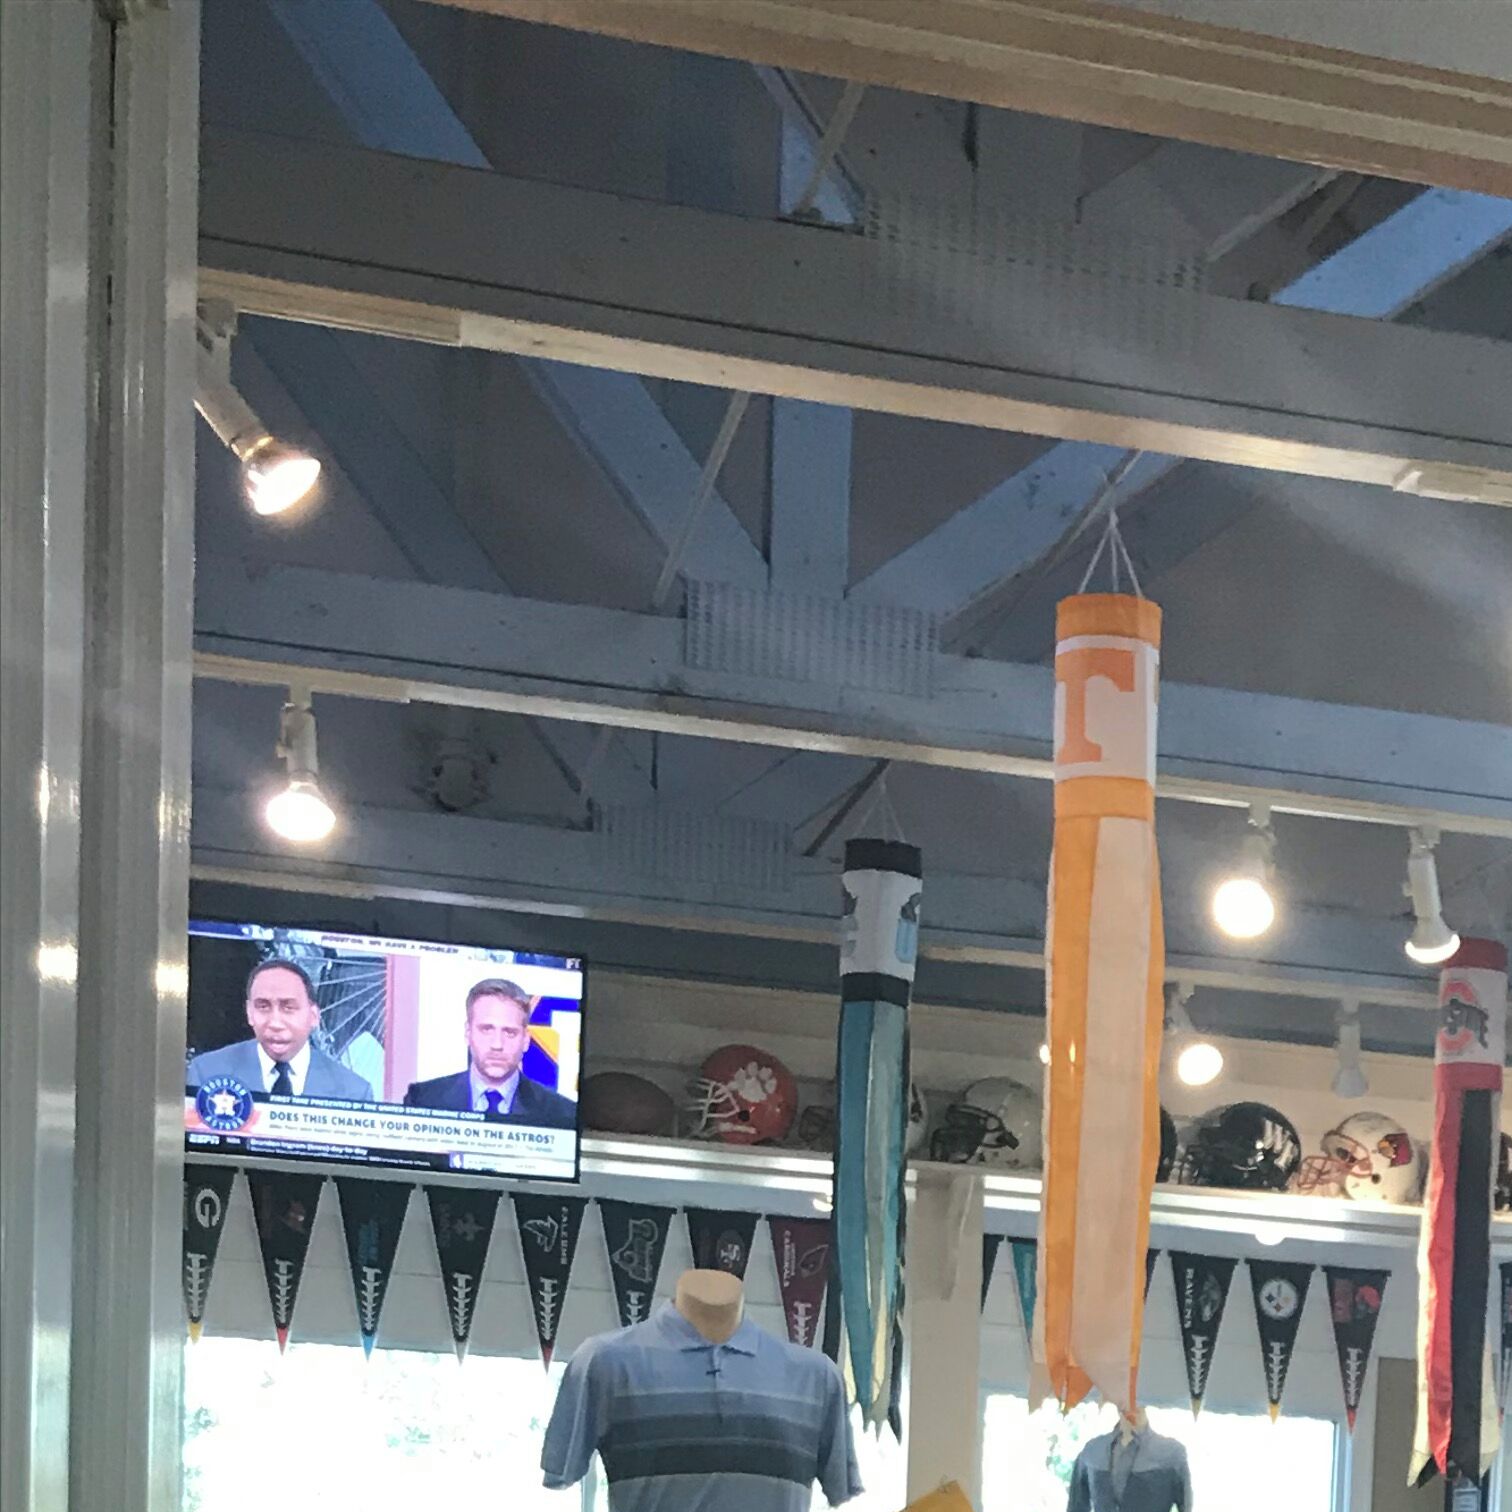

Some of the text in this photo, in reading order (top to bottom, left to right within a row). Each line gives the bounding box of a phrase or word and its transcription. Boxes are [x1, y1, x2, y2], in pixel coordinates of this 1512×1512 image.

[269, 1111, 555, 1145] DOES THIS CHANGE YOUR OPINION ON THE ASTROS?
[1184, 1268, 1194, 1329] RAVENS
